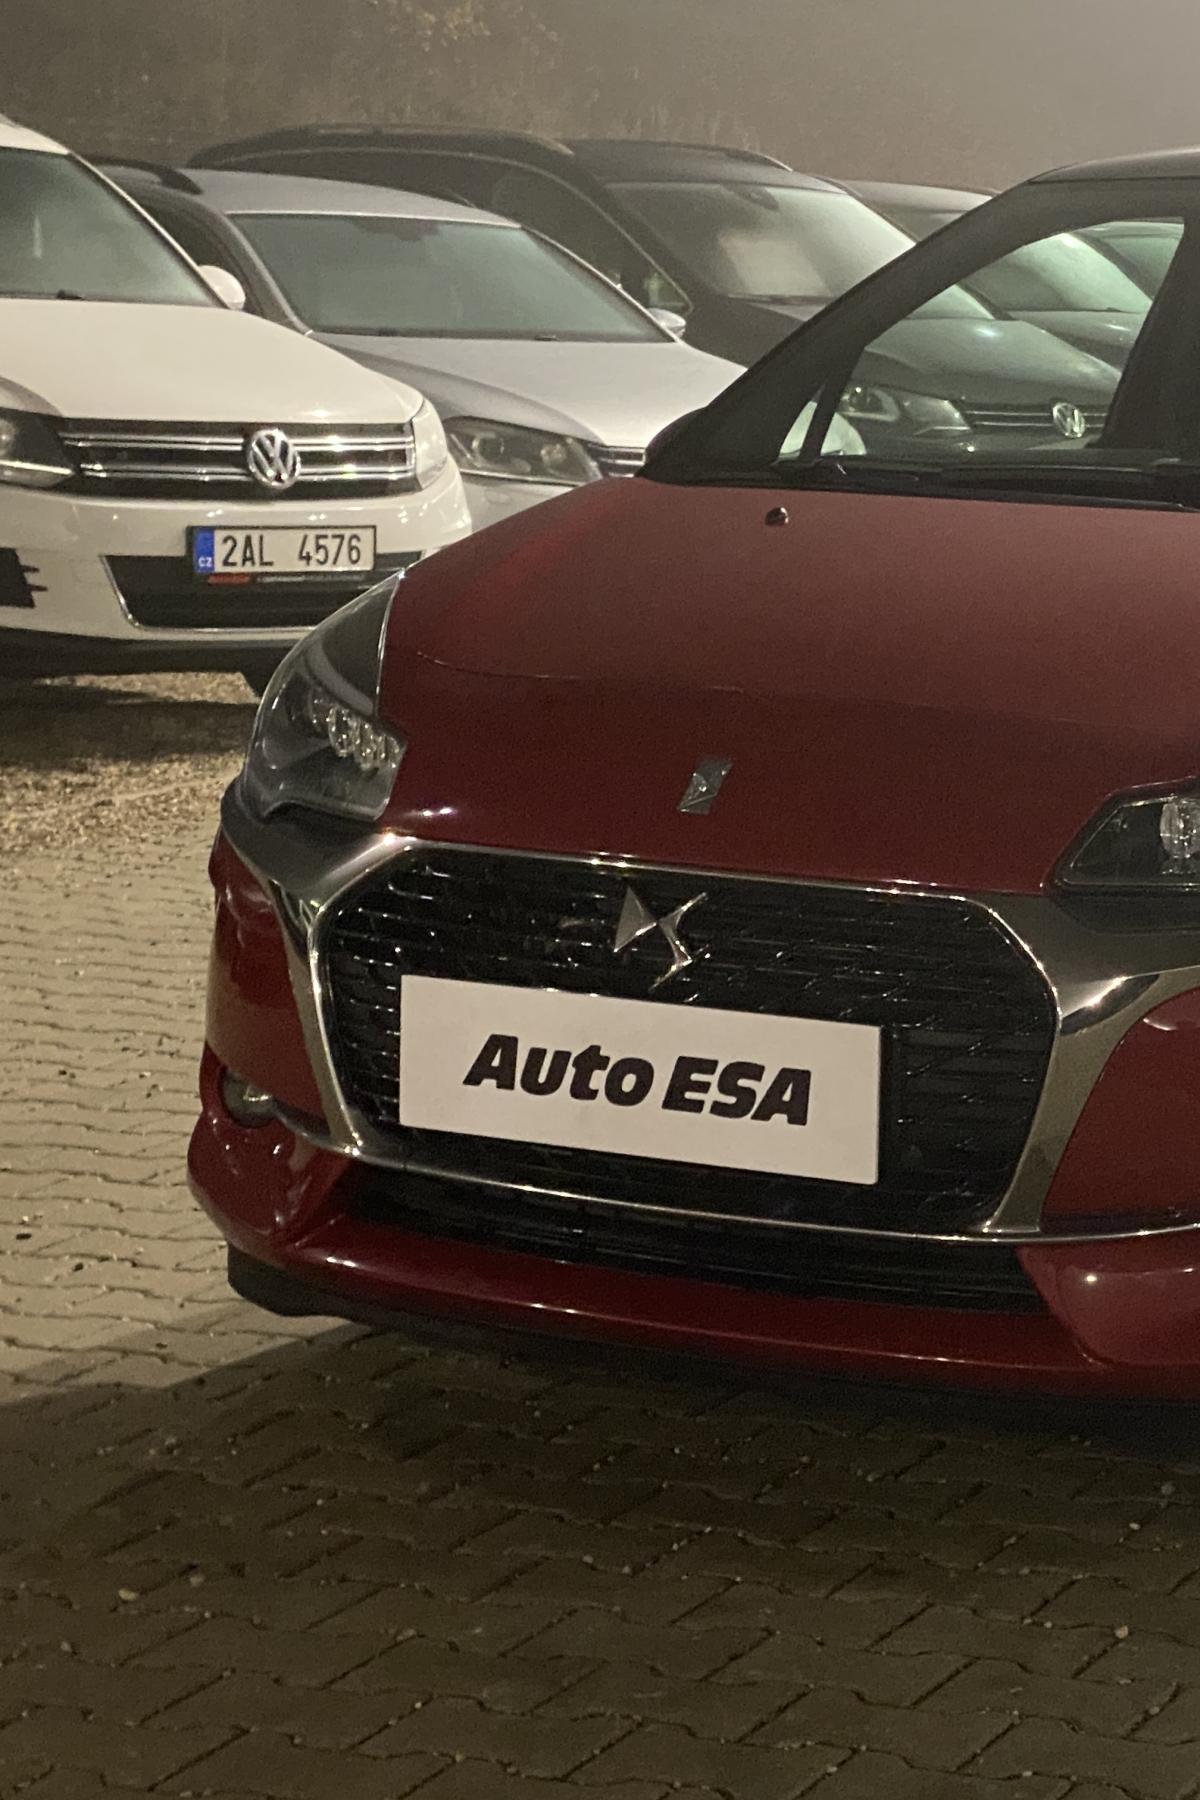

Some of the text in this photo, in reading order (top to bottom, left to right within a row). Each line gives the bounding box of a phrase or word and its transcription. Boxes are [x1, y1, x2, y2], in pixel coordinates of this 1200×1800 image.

[198, 557, 212, 568] CZ
[221, 534, 361, 567] 2AL 4576
[462, 1033, 812, 1127] Auto ESA
